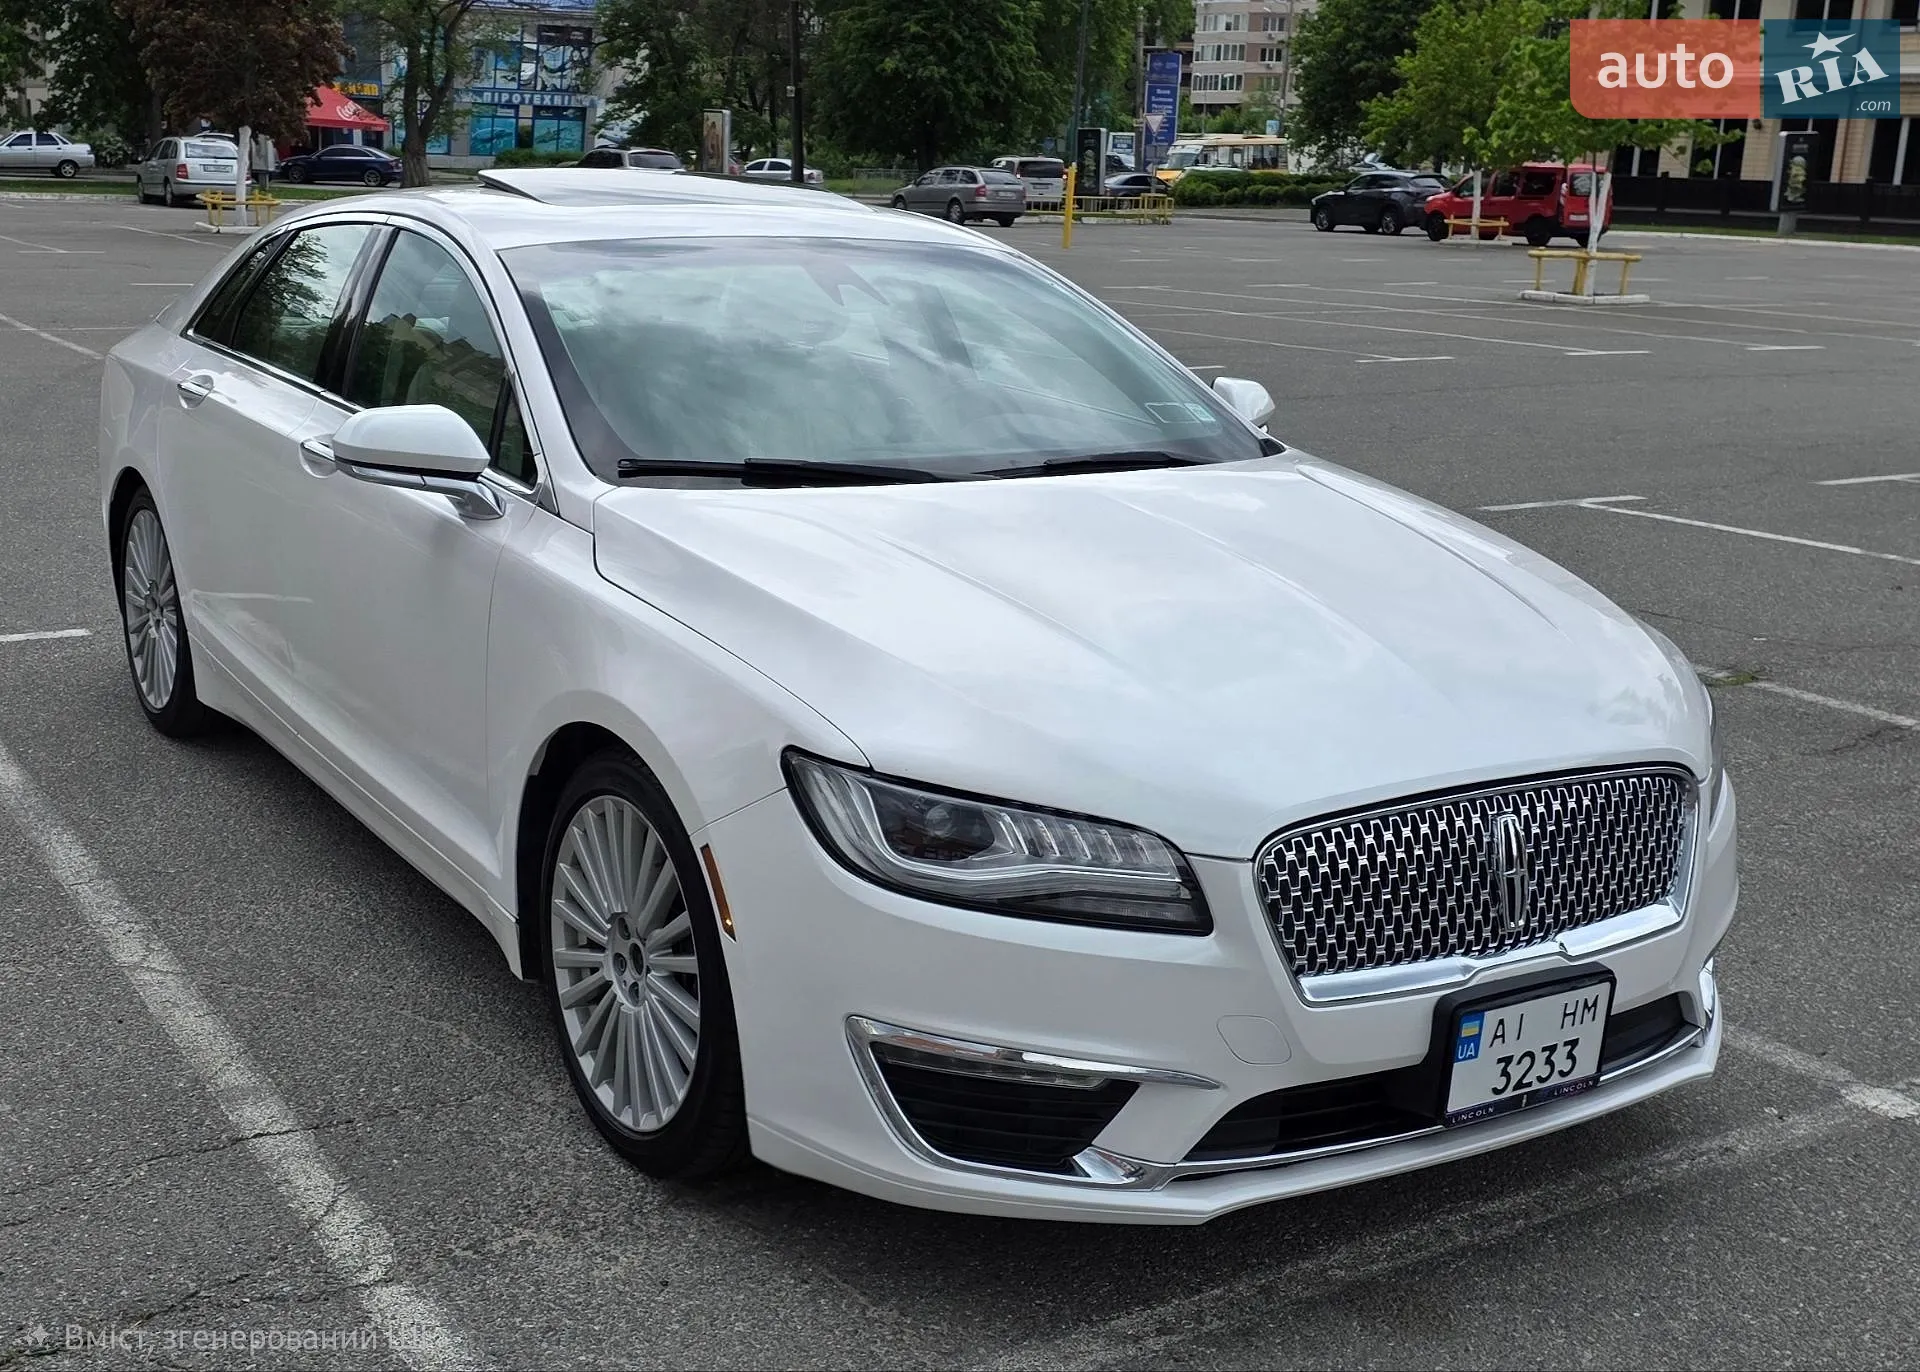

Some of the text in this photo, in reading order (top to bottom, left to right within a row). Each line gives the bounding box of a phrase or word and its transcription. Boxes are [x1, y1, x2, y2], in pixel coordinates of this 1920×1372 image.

[483, 92, 589, 106] ПІРОТЕХНІ
[1489, 994, 1600, 1049] AI HM
[1458, 1043, 1475, 1059] UA
[1491, 1037, 1581, 1096] 3233
[1554, 1081, 1594, 1096] LINCOLN
[1452, 1106, 1494, 1123] LINCOLN
